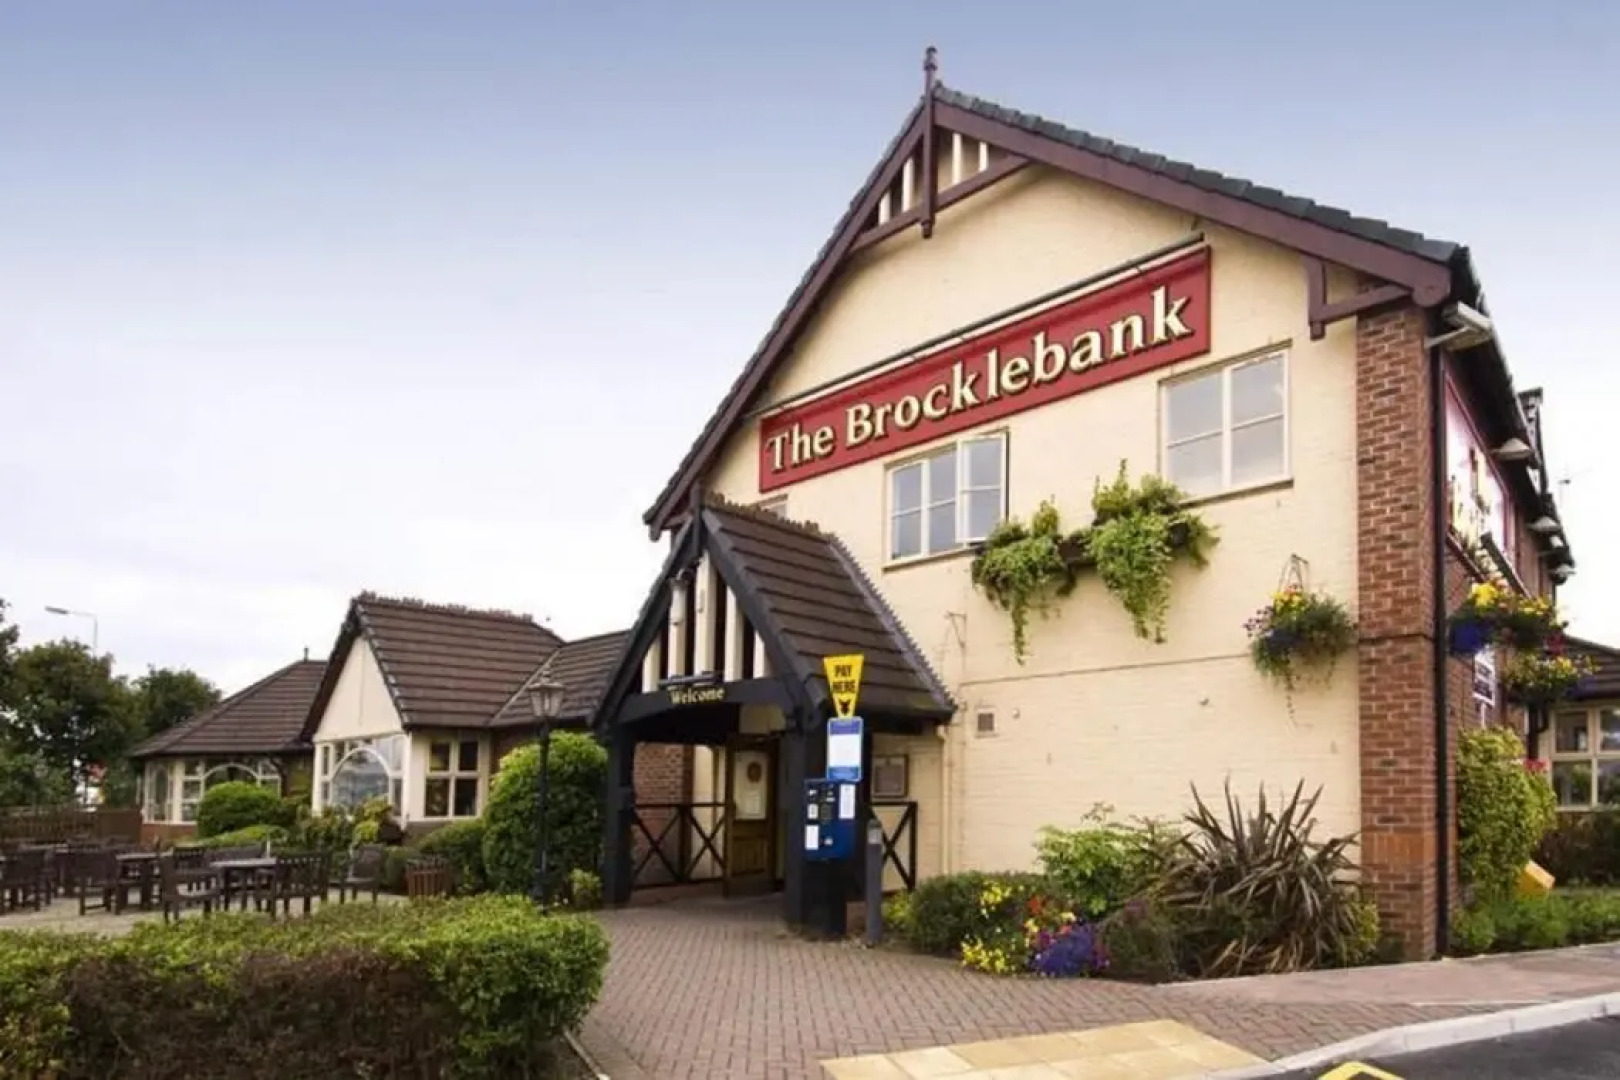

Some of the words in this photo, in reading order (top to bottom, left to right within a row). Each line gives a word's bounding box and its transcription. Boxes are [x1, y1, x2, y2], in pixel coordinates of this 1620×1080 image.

[766, 422, 835, 473] The
[845, 283, 1195, 448] Brocklebank
[834, 664, 852, 677] PAY
[832, 680, 856, 694] HERE
